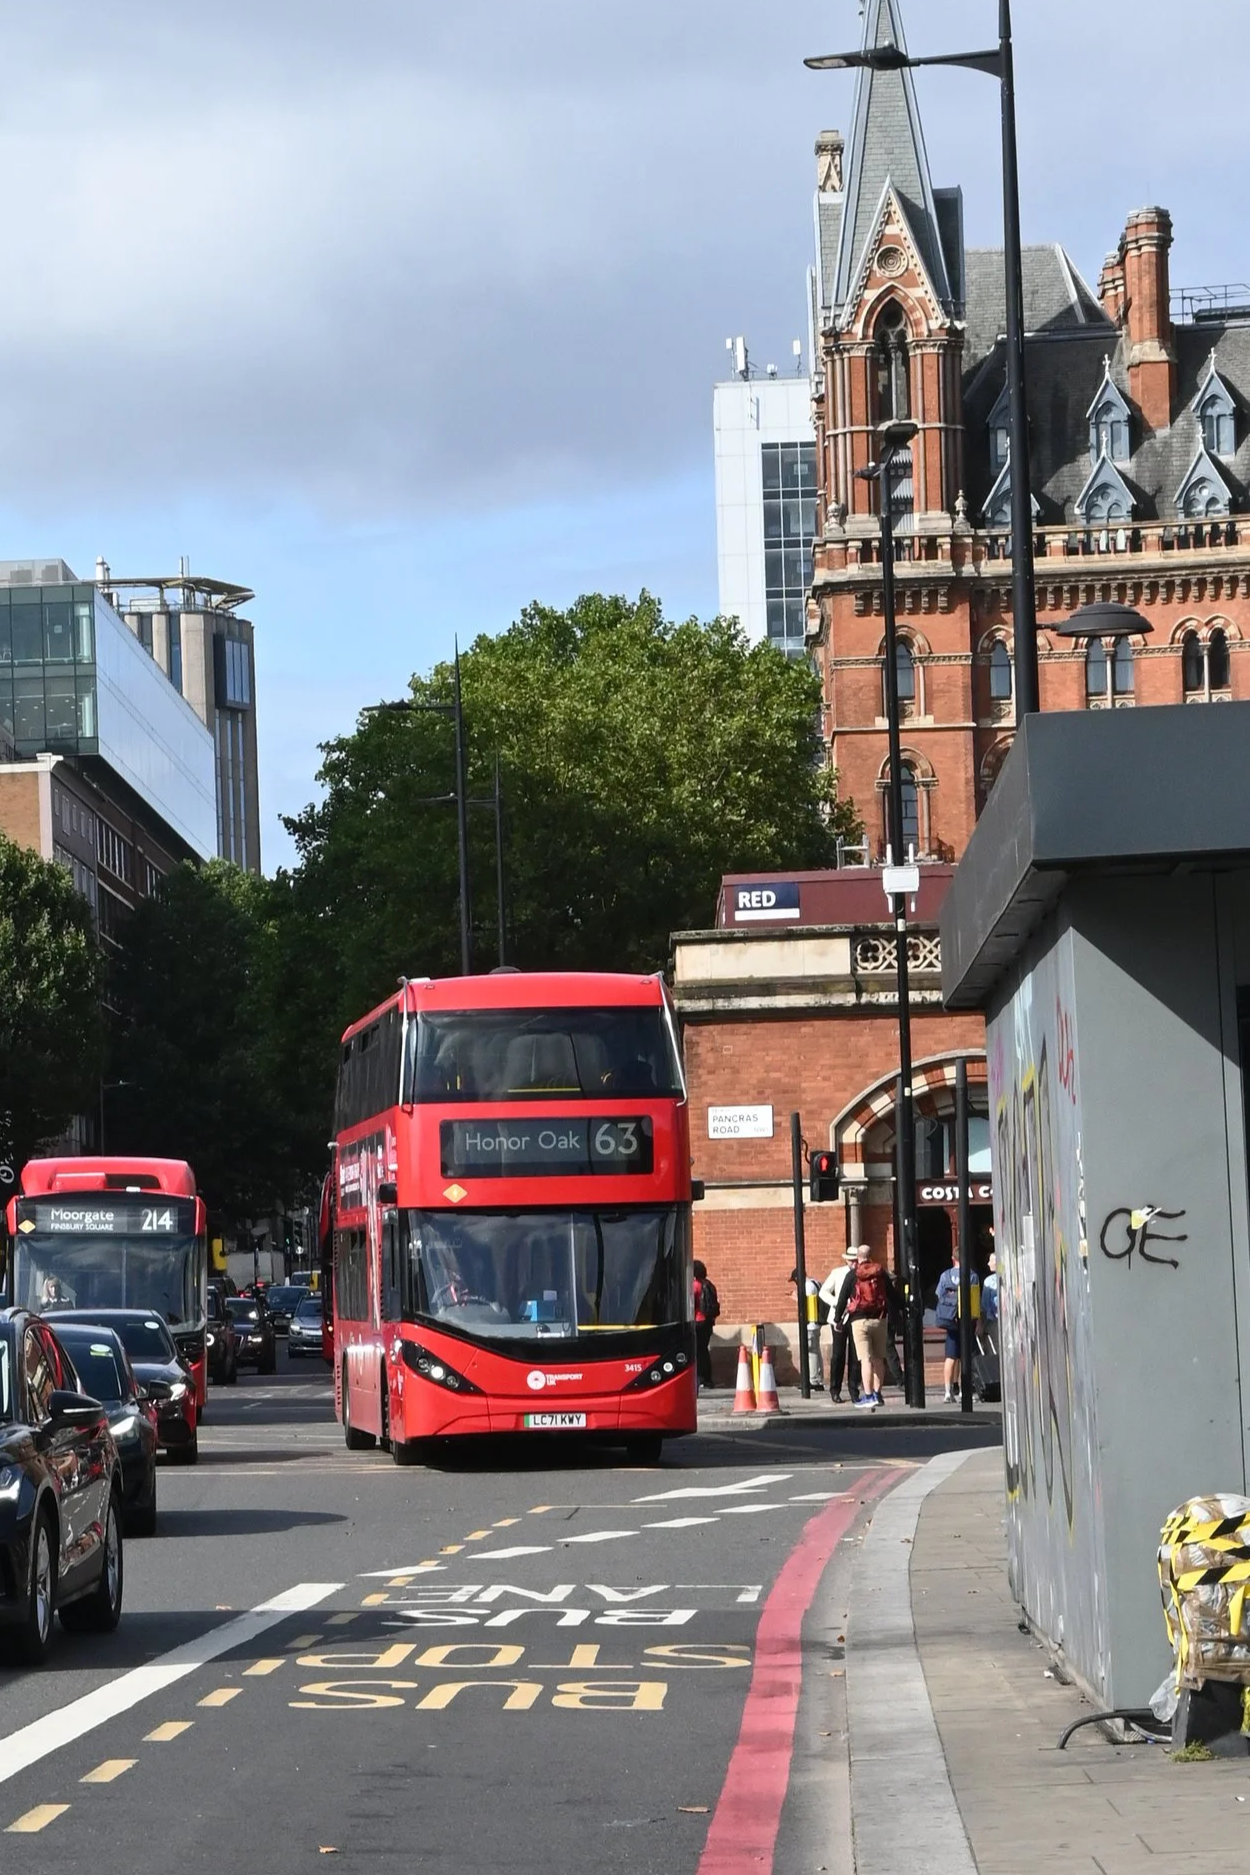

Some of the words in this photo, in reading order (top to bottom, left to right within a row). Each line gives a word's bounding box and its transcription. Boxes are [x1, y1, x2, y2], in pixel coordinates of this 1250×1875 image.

[738, 890, 776, 908] RED
[712, 1113, 759, 1123] PANCRAS
[466, 1132, 530, 1151] Honor
[538, 1131, 580, 1149] Oak
[595, 1122, 638, 1155] 63
[712, 1125, 740, 1134] ROAD
[50, 1223, 84, 1231] FINSBURY
[85, 1223, 114, 1231] SQUARE
[51, 1208, 114, 1222] Moorgate
[141, 1208, 173, 1231] 214
[624, 1364, 642, 1372] 3415
[533, 1415, 558, 1426] LC71
[560, 1415, 582, 1425] KWY
[382, 1584, 763, 1604] LANE
[380, 1608, 700, 1627] BUS
[295, 1643, 752, 1669] STOP
[288, 1680, 668, 1711] BUS
